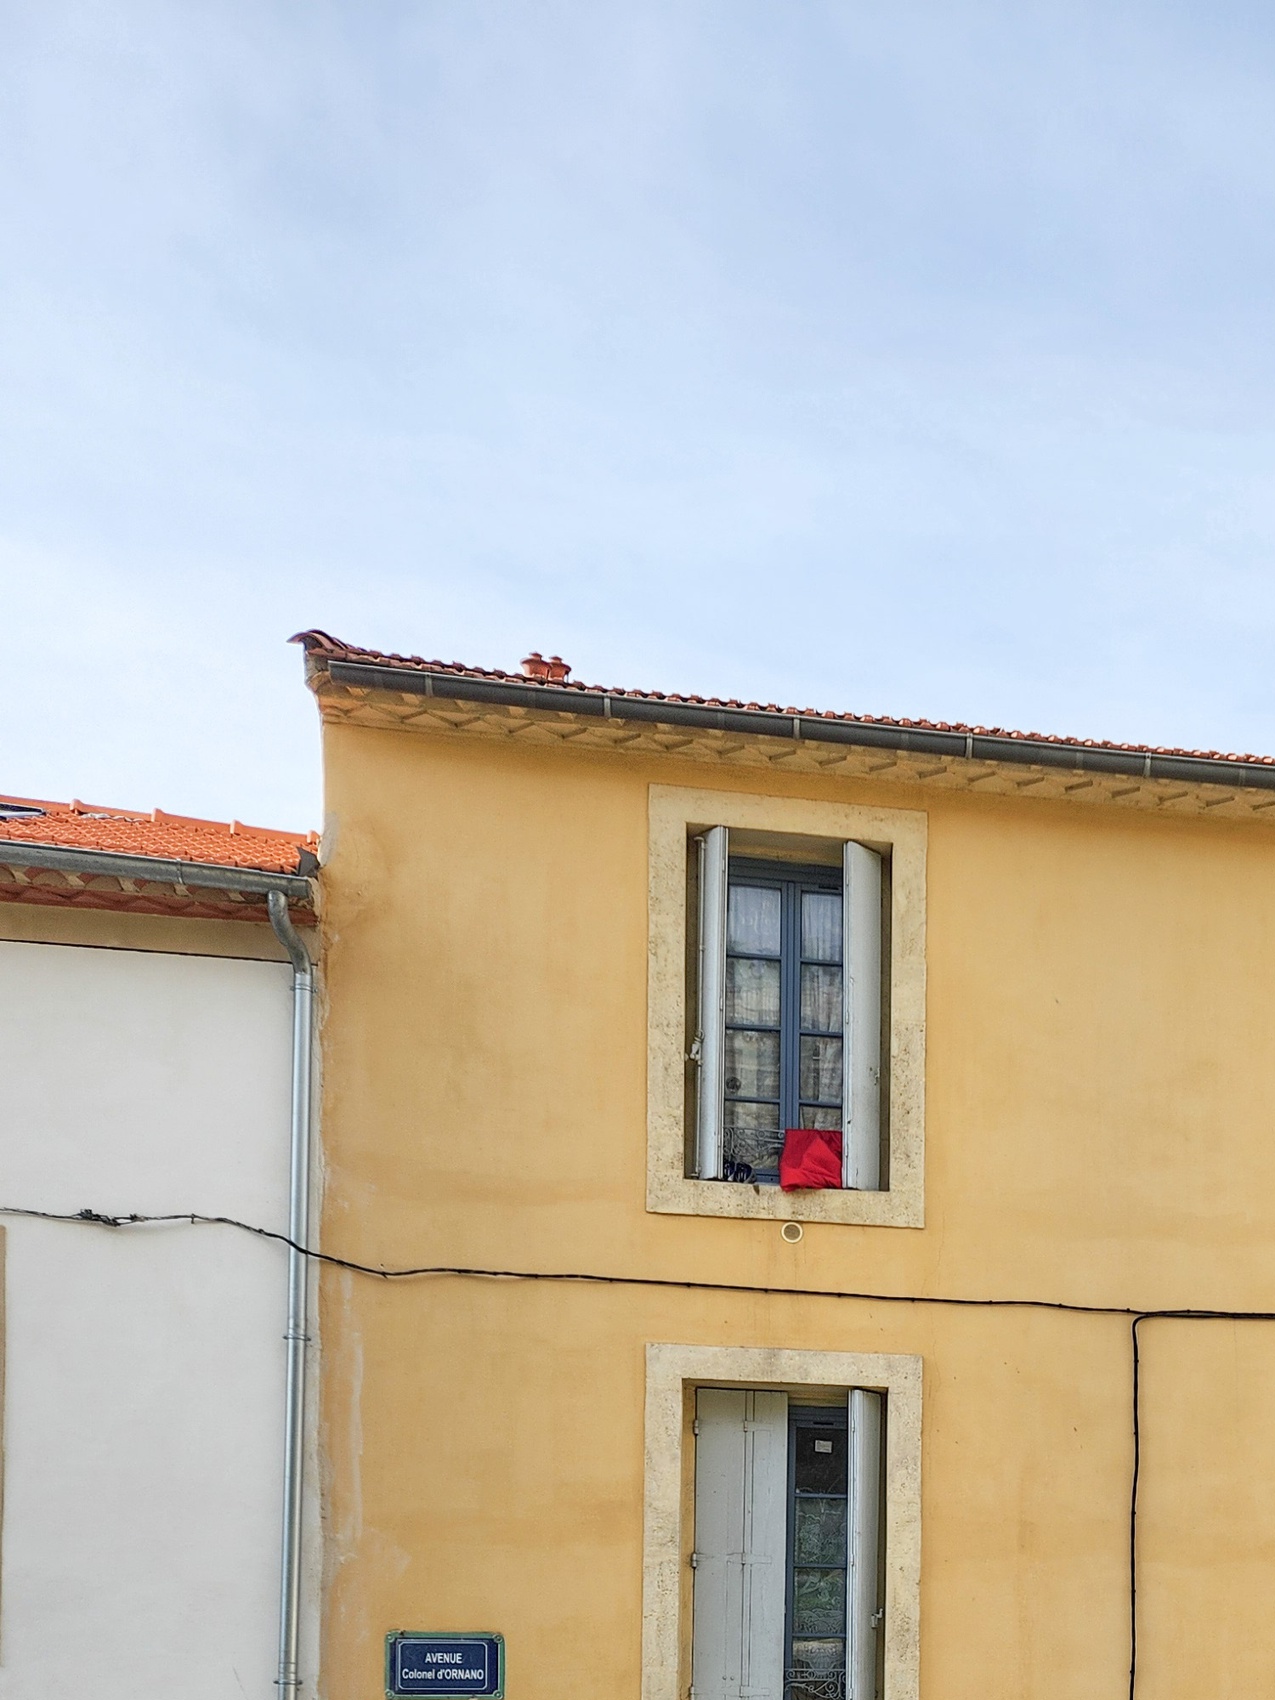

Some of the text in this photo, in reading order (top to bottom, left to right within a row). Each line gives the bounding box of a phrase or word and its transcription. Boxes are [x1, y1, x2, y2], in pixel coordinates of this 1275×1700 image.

[425, 1653, 463, 1664] AVENUE
[402, 1668, 484, 1680] Colonel d'ORNANO
